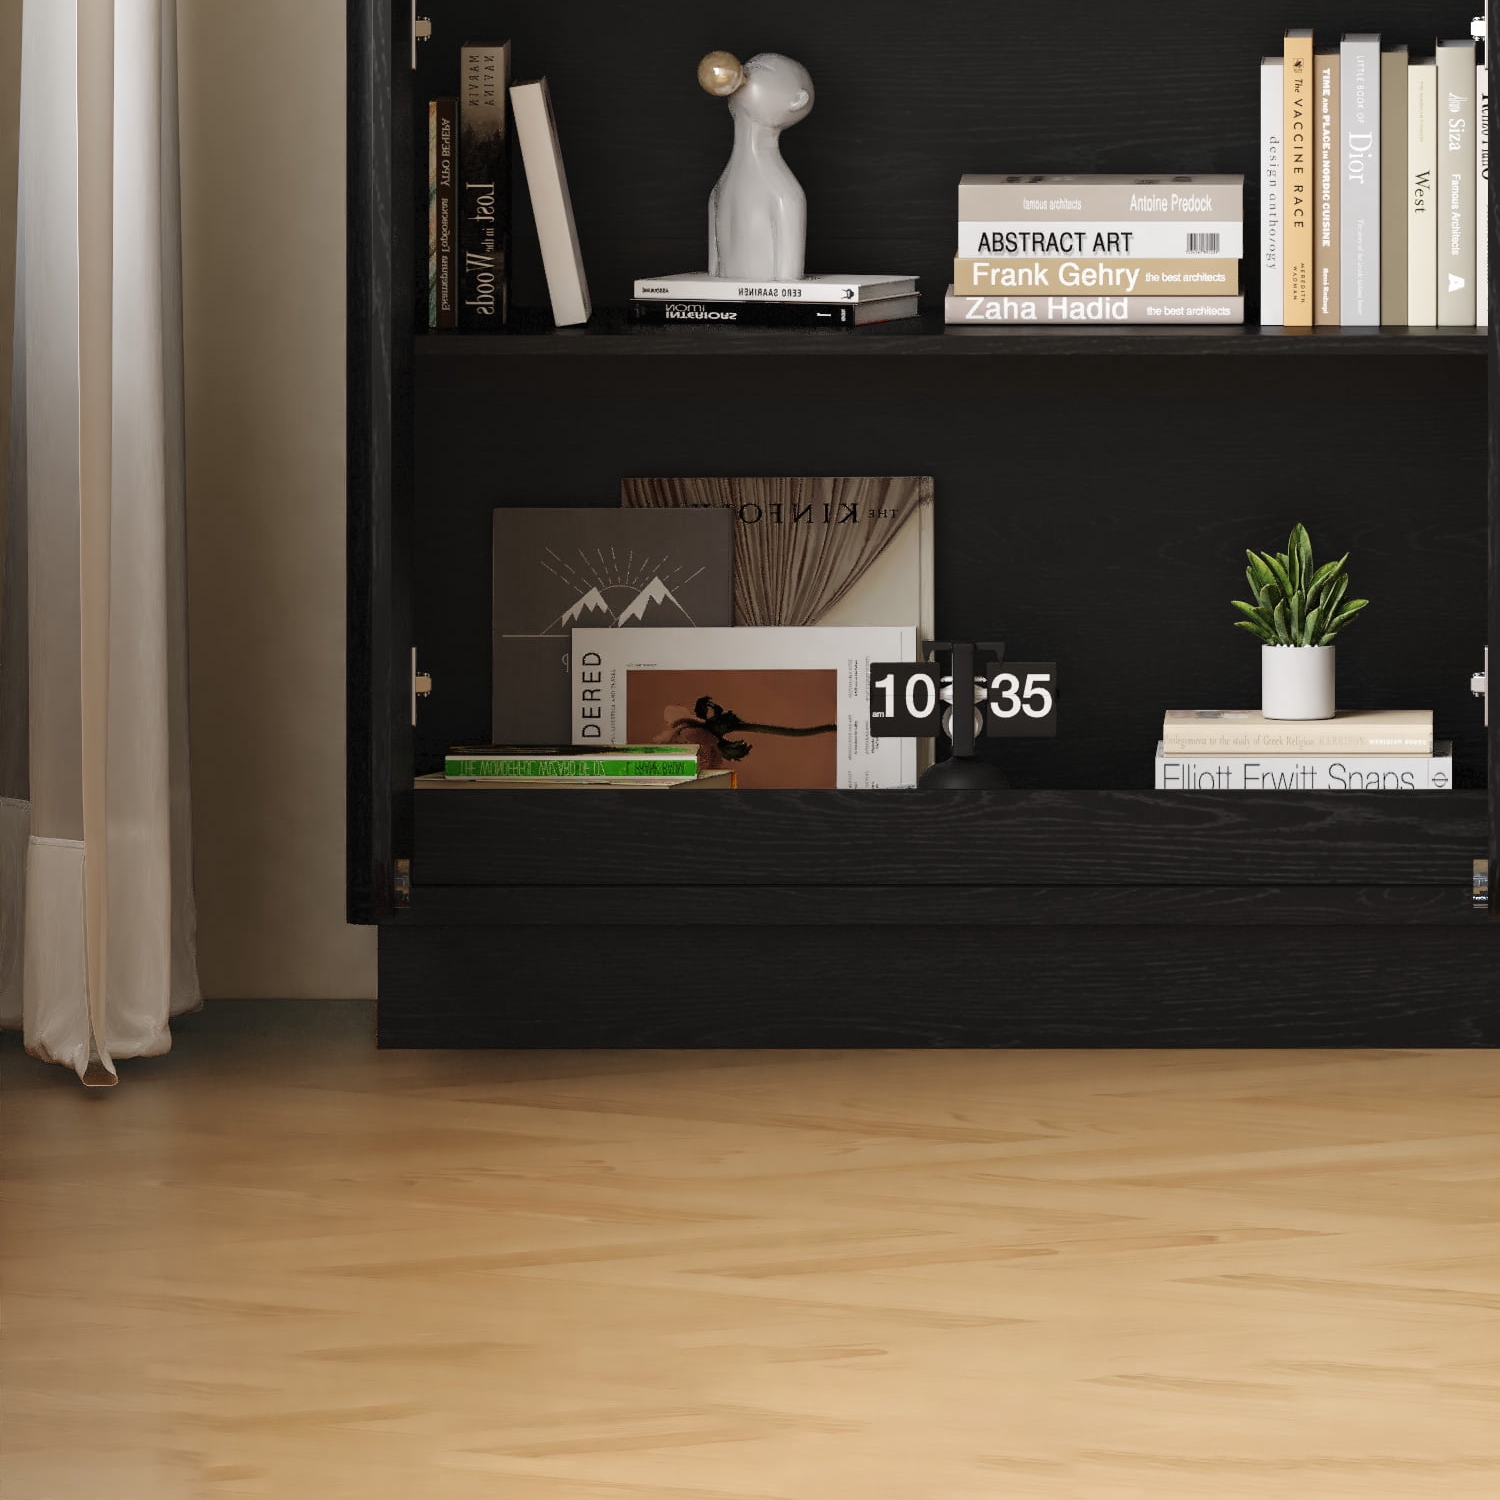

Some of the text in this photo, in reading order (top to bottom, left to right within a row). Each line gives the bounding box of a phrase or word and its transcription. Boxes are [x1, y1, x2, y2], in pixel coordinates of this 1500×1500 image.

[1322, 68, 1331, 96] TIME
[1356, 85, 1365, 109] BOOK
[1322, 115, 1331, 150] PLACE
[1356, 113, 1365, 124] OF
[1447, 118, 1466, 151] Siza
[1268, 135, 1280, 188] design
[1293, 78, 1304, 229] The VACCINE RACE
[1322, 151, 1329, 160] IN
[1348, 132, 1373, 184] Dior
[1322, 160, 1331, 201] NORDIC
[1414, 169, 1430, 214] West
[1023, 197, 1082, 211] famous architects
[1130, 193, 1213, 212] Antoine Predock
[1451, 174, 1461, 256] Famous Architects
[1322, 202, 1331, 247] CUISINE
[977, 232, 1133, 253] ABSTRACT ART
[972, 262, 1141, 292] Frank Gehry
[1145, 272, 1226, 283] the best architects
[1447, 273, 1465, 293] A
[965, 296, 1129, 320] Zaha Hadid
[1147, 306, 1231, 316] the best architects
[875, 673, 936, 718] 10
[990, 673, 1053, 718] 35
[1209, 737, 1217, 746] to
[1219, 736, 1231, 746] the
[1253, 736, 1263, 746] of
[1263, 736, 1284, 746] Greek
